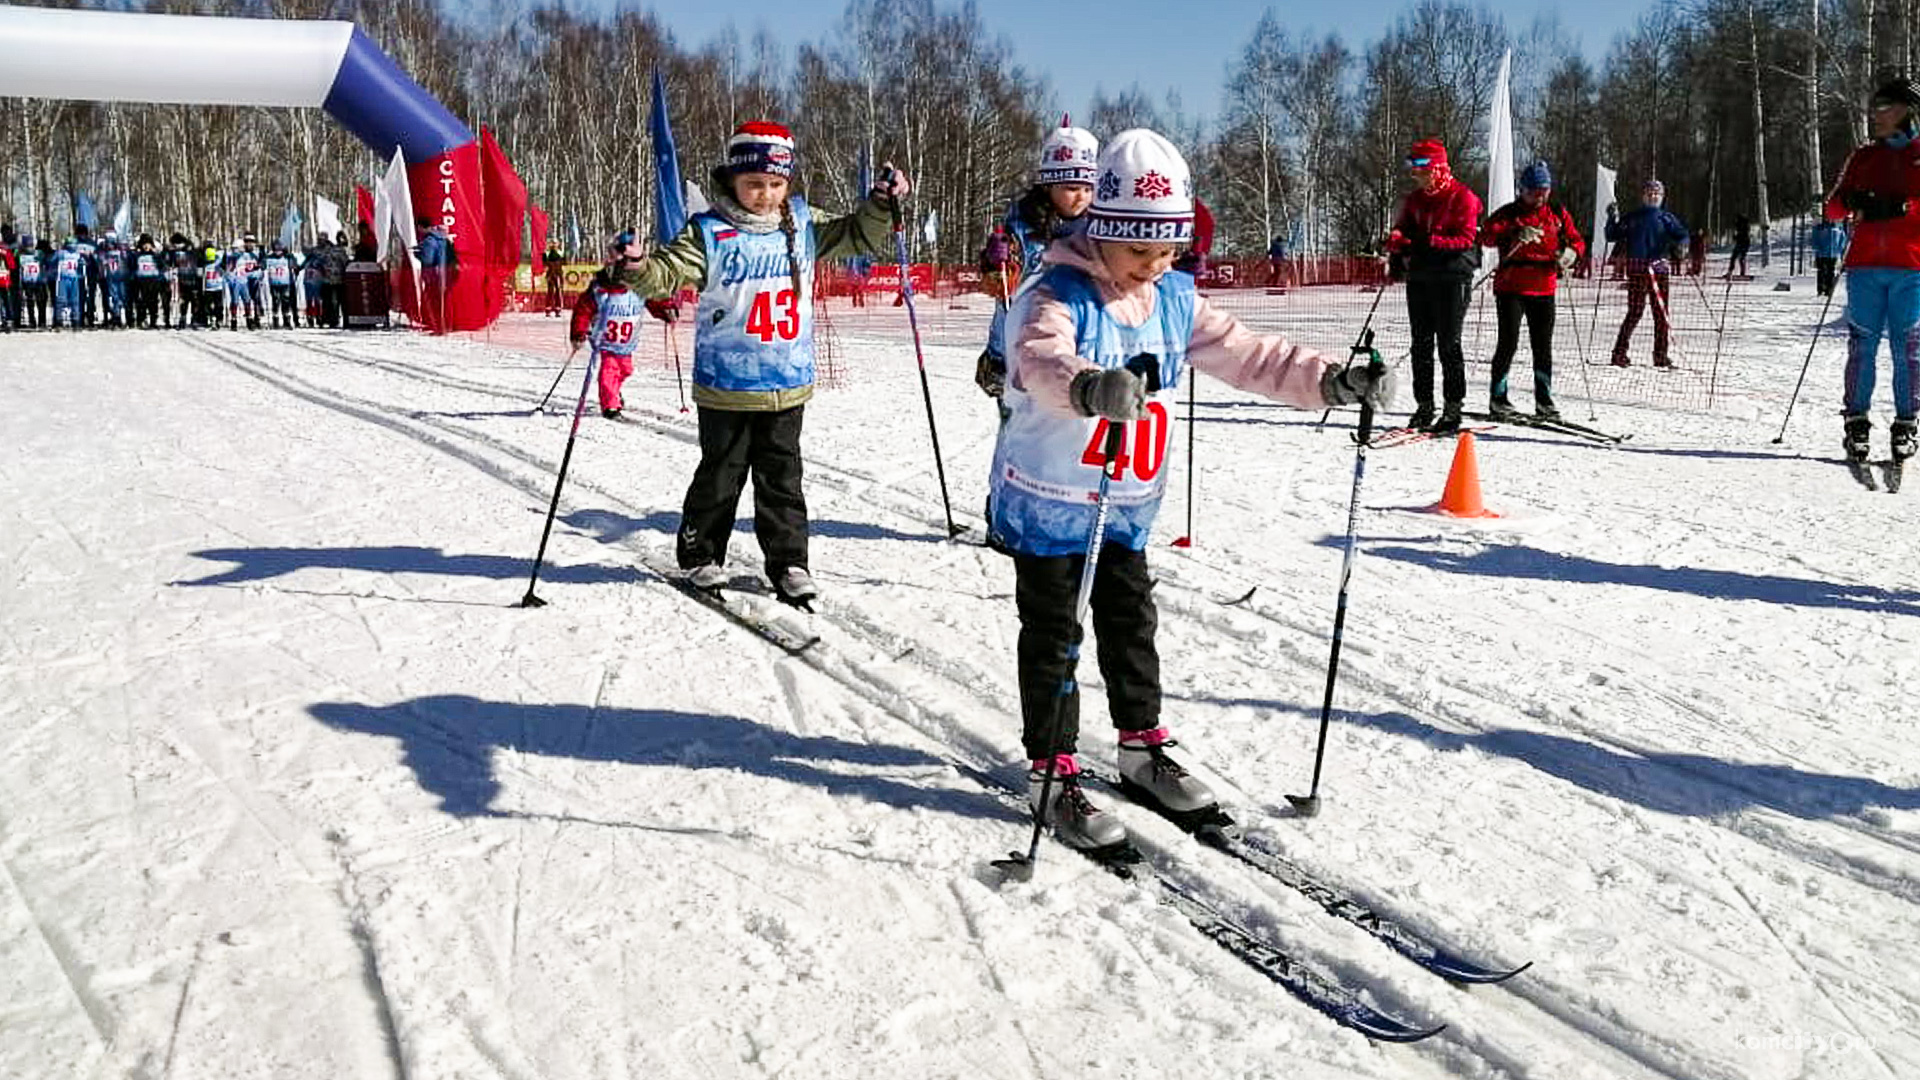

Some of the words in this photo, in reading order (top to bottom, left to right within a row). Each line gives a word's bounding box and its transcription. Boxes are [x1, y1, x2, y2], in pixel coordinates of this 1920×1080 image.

[1086, 218, 1176, 239] ЛЫЖНЯ
[604, 319, 633, 344] 39
[745, 288, 800, 342] 43
[1081, 401, 1168, 482] 40
